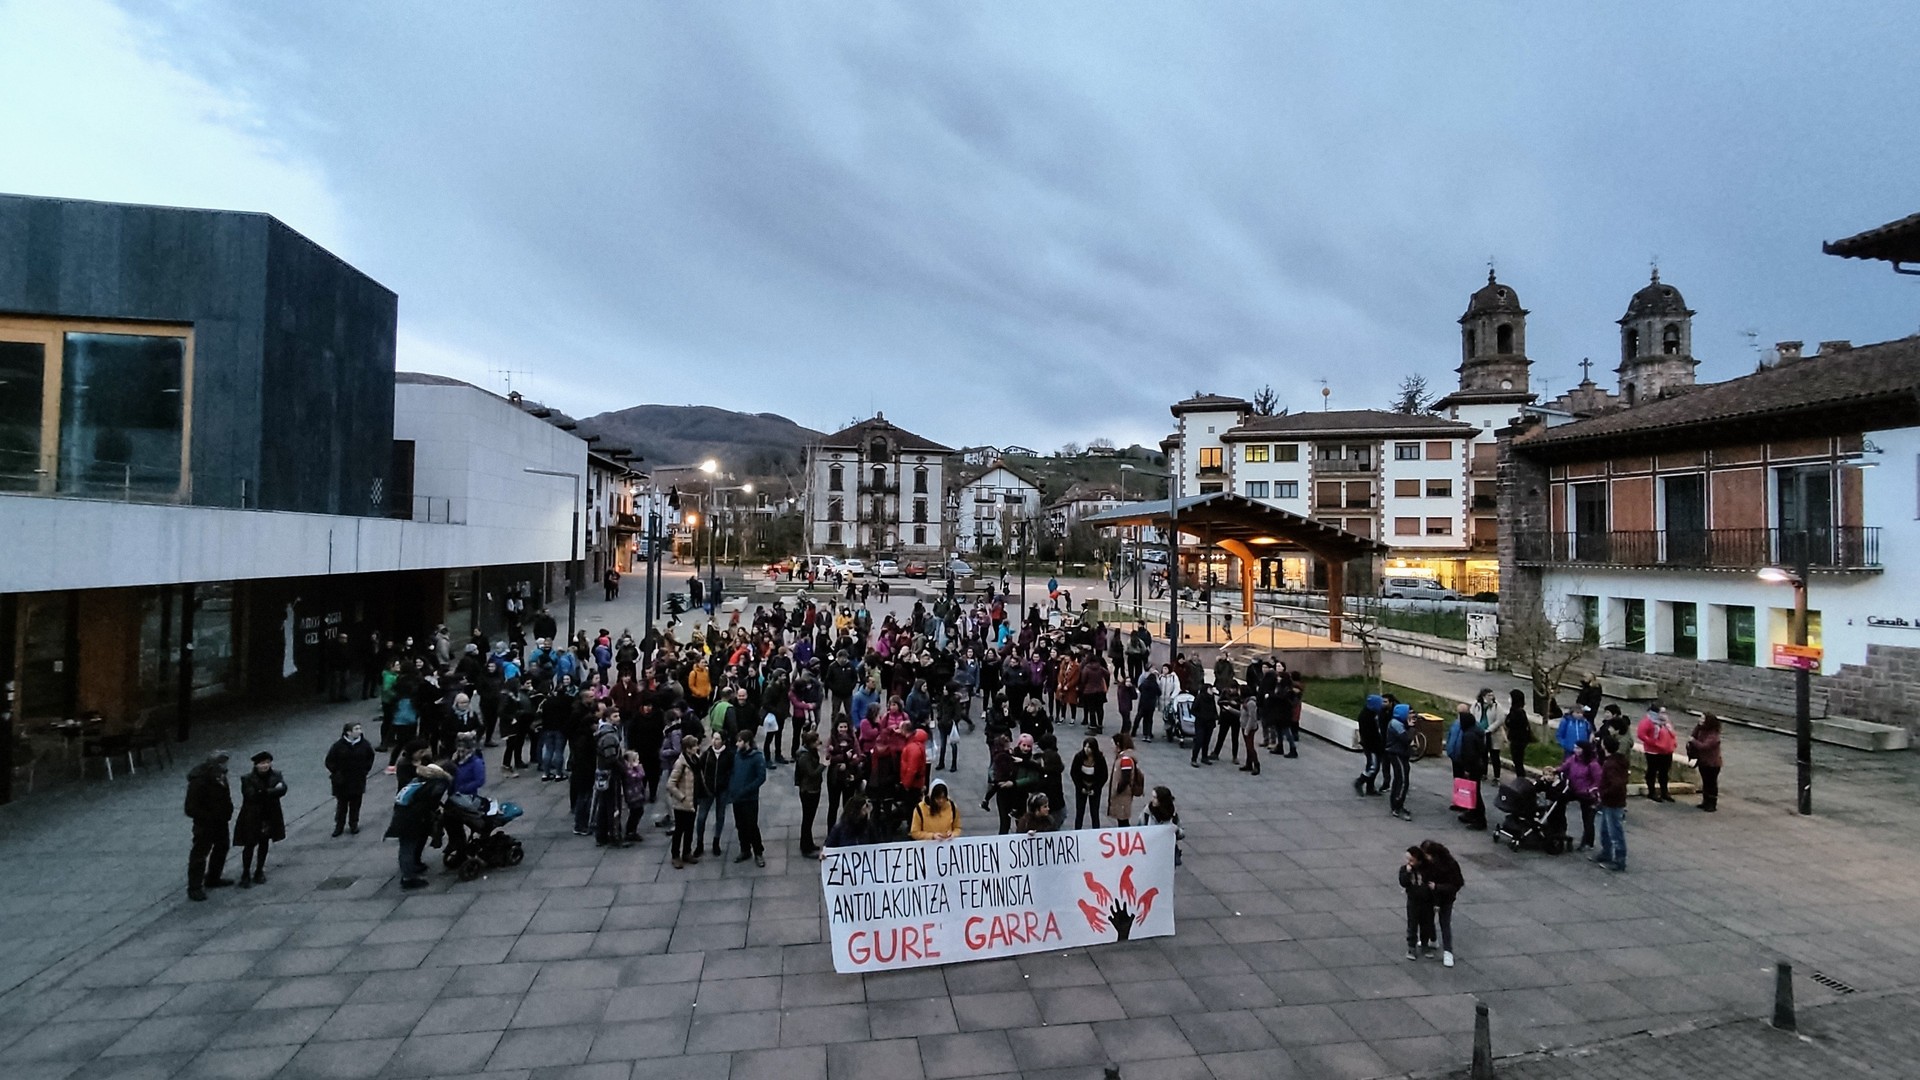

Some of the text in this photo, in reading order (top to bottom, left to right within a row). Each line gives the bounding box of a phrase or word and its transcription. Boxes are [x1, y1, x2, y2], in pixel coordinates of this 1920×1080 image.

[827, 847, 927, 887] ZAPALTZEN
[936, 842, 1000, 878] GAITUEN
[1099, 831, 1147, 859] SUA
[832, 874, 1034, 924] ANTOLAKUNTZA FEMINISTA
[964, 911, 1063, 951] GARRA
